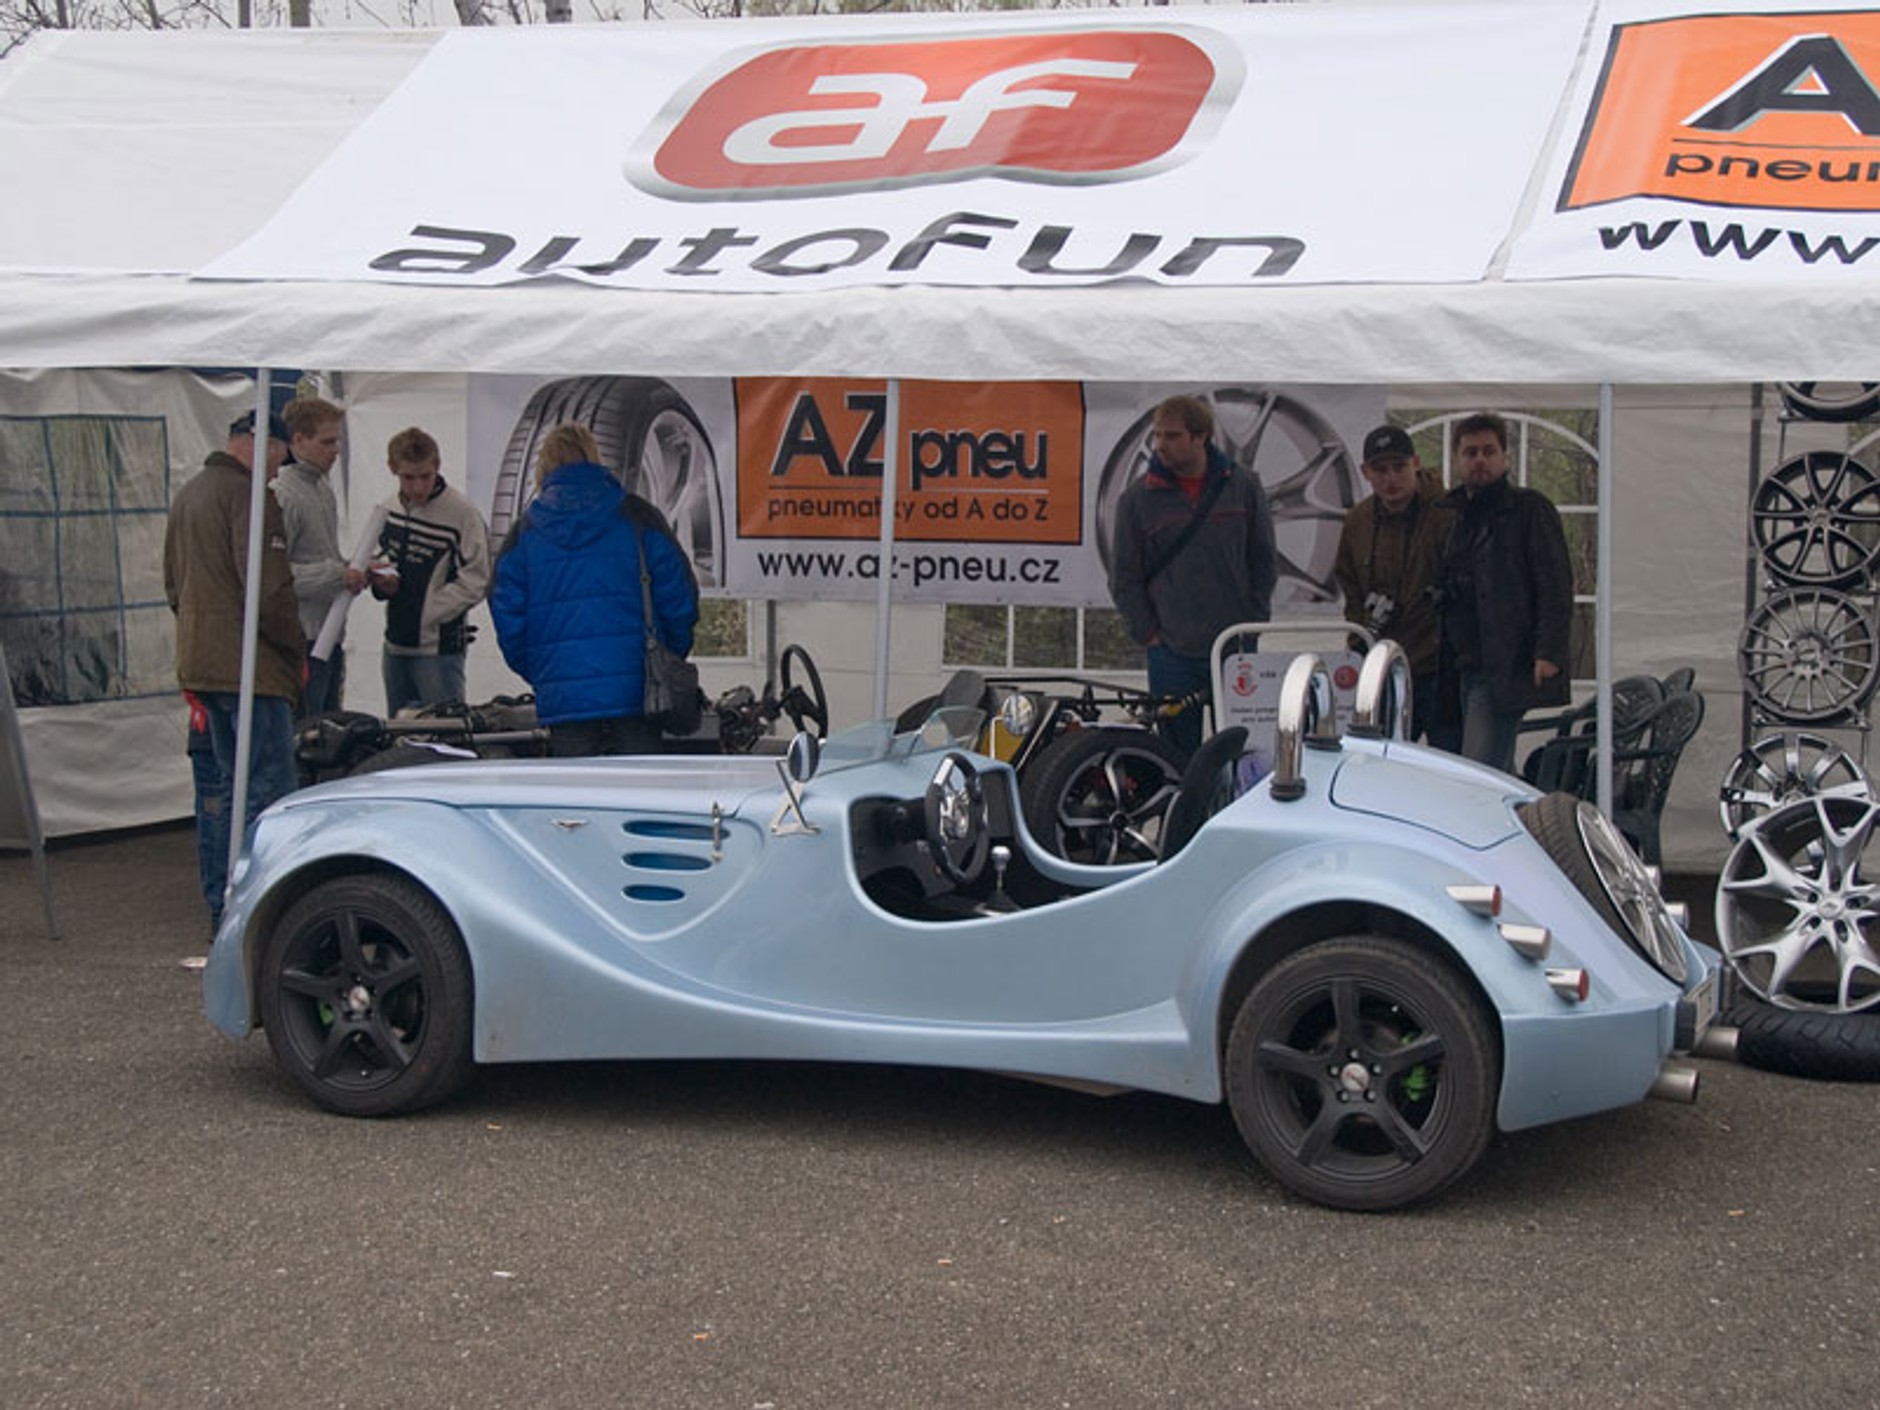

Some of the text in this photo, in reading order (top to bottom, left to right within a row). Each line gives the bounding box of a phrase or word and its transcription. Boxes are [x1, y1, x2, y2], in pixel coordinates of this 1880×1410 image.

[1664, 153, 1880, 182] pneu
[771, 391, 1049, 492] AZ pneu
[768, 497, 1049, 522] pneumaty od A do Z
